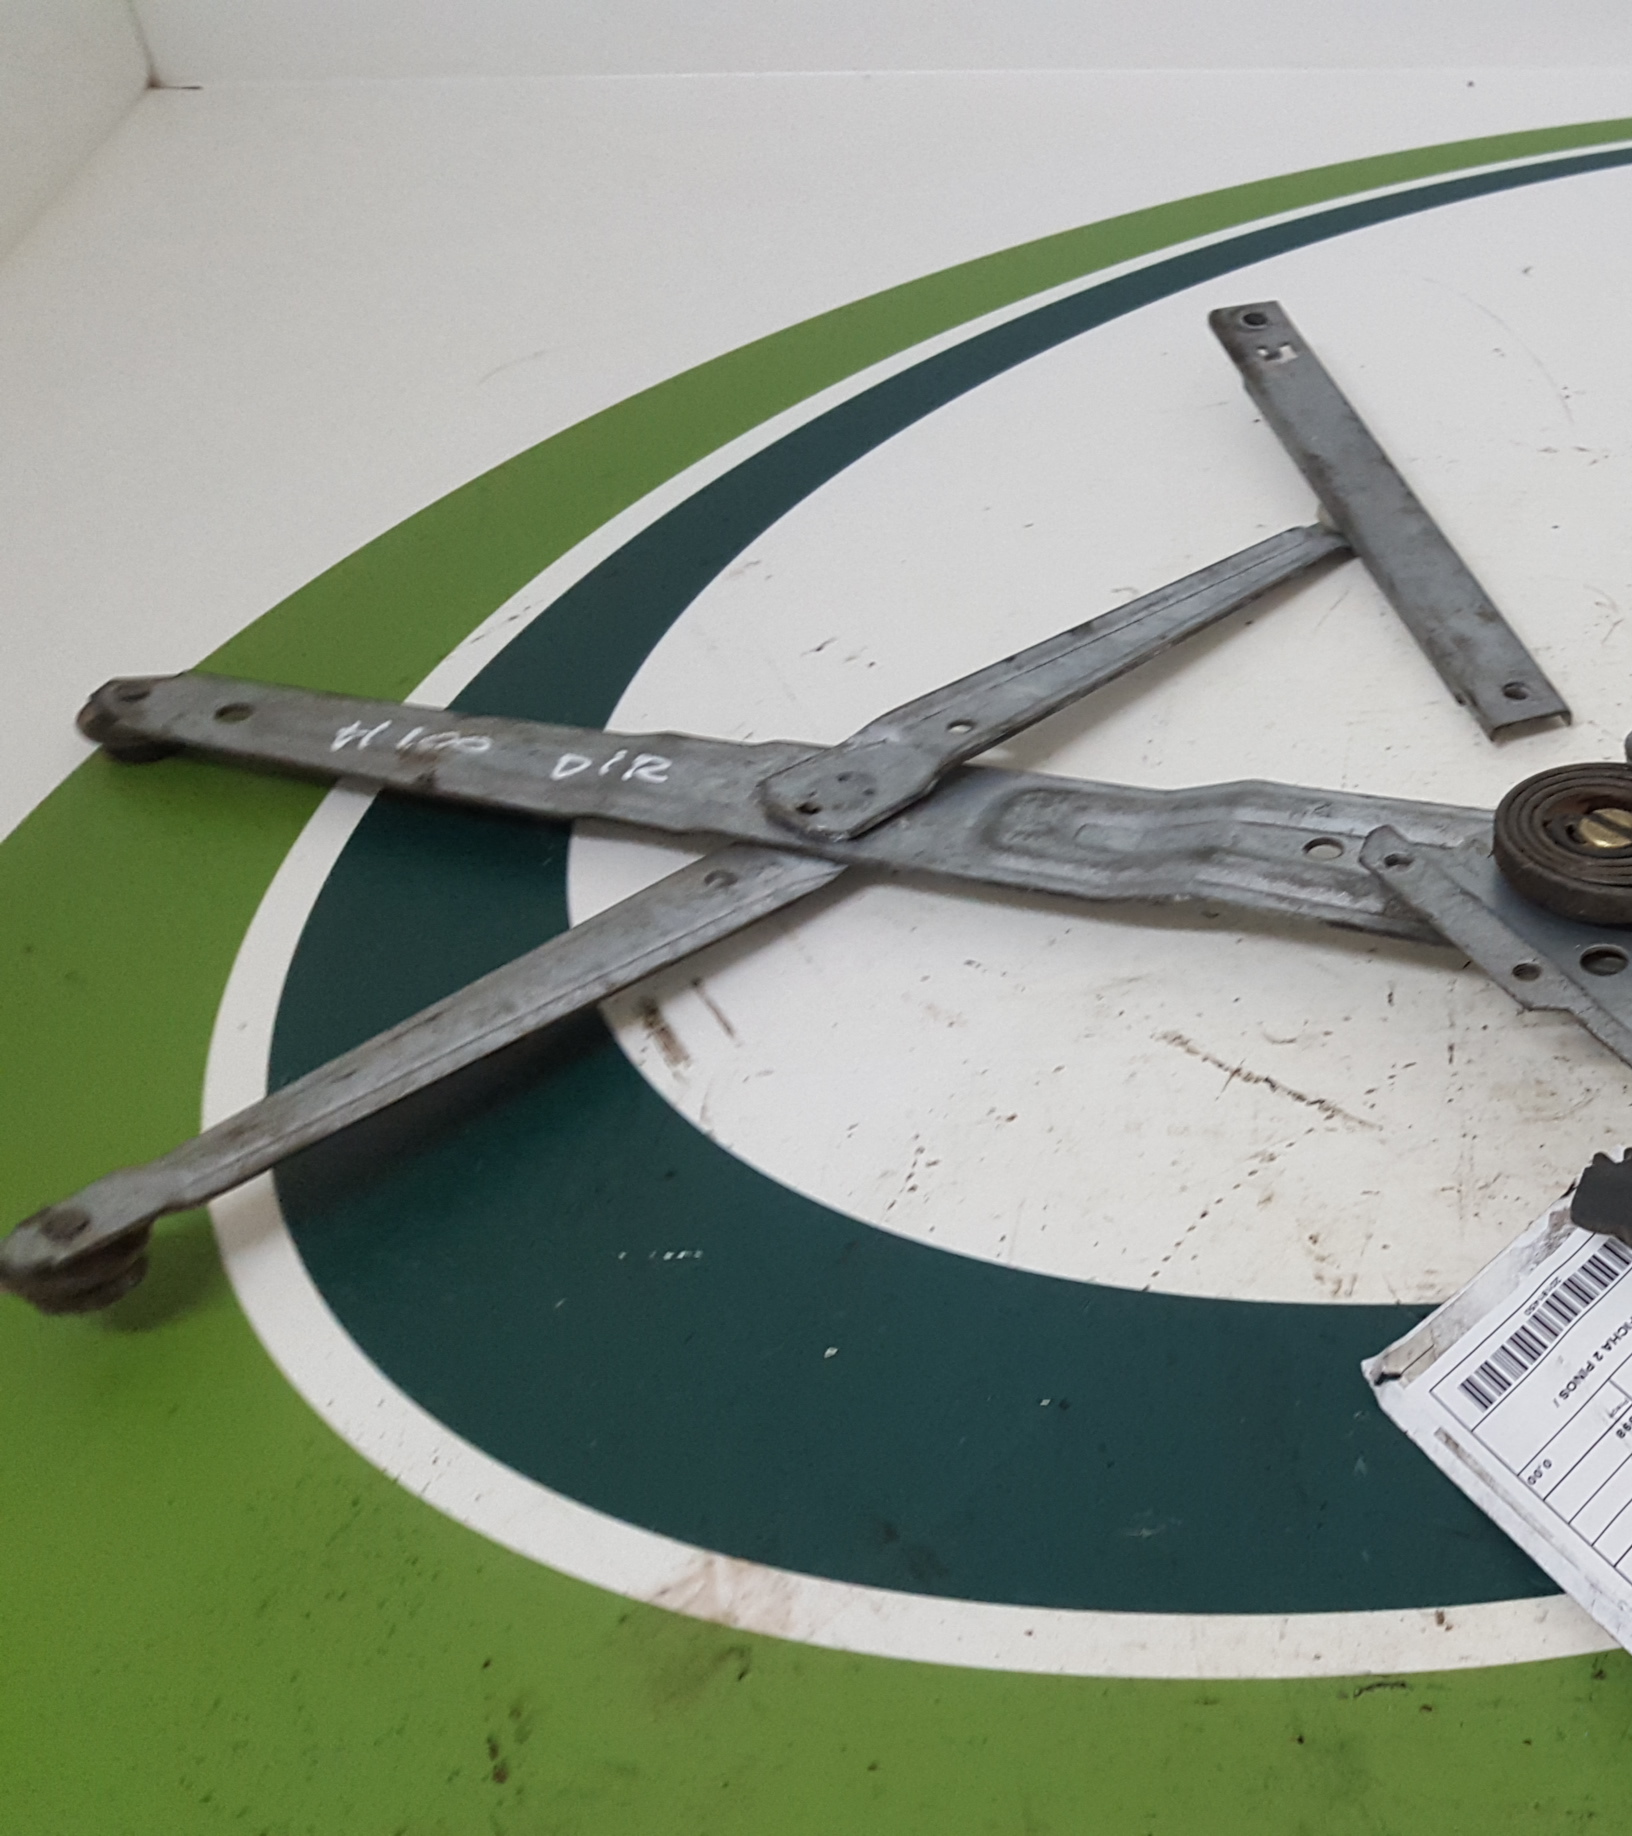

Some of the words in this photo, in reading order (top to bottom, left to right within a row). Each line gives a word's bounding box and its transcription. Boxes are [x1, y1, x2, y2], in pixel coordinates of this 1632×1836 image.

[551, 749, 673, 784] DIR
[1592, 1351, 1604, 1362] 2
[1558, 1360, 1596, 1400] PINOS
